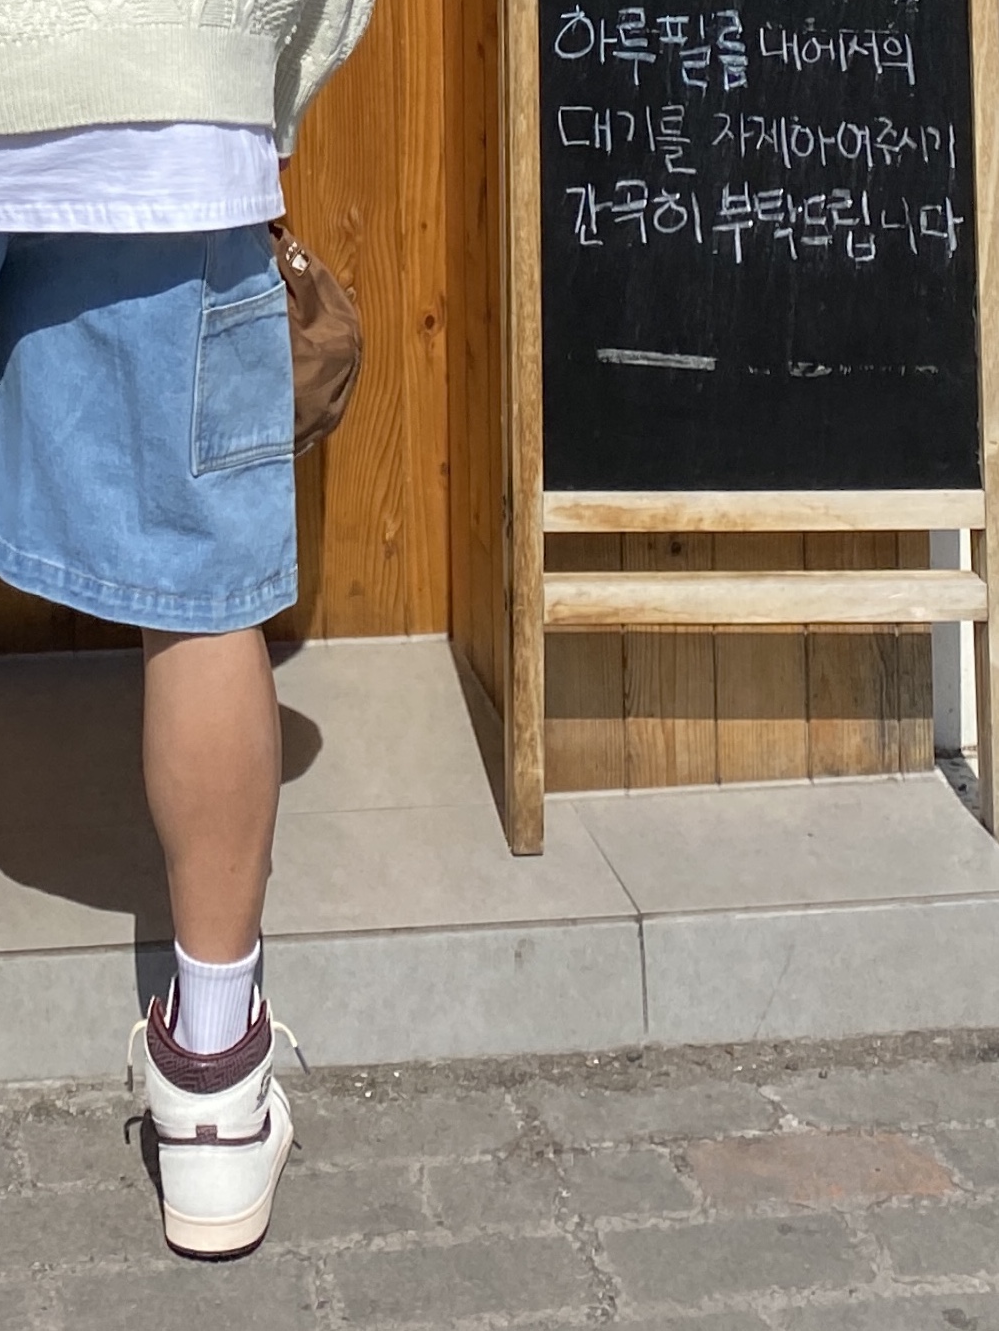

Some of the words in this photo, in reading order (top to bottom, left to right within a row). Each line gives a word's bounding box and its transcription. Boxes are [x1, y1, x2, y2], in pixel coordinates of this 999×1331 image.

[554, 4, 748, 92] 하루필름
[760, 25, 916, 85] 내에서의
[558, 105, 697, 175] 대기를
[565, 179, 704, 246] 간곡히
[711, 180, 965, 265] 부탁드립니다
